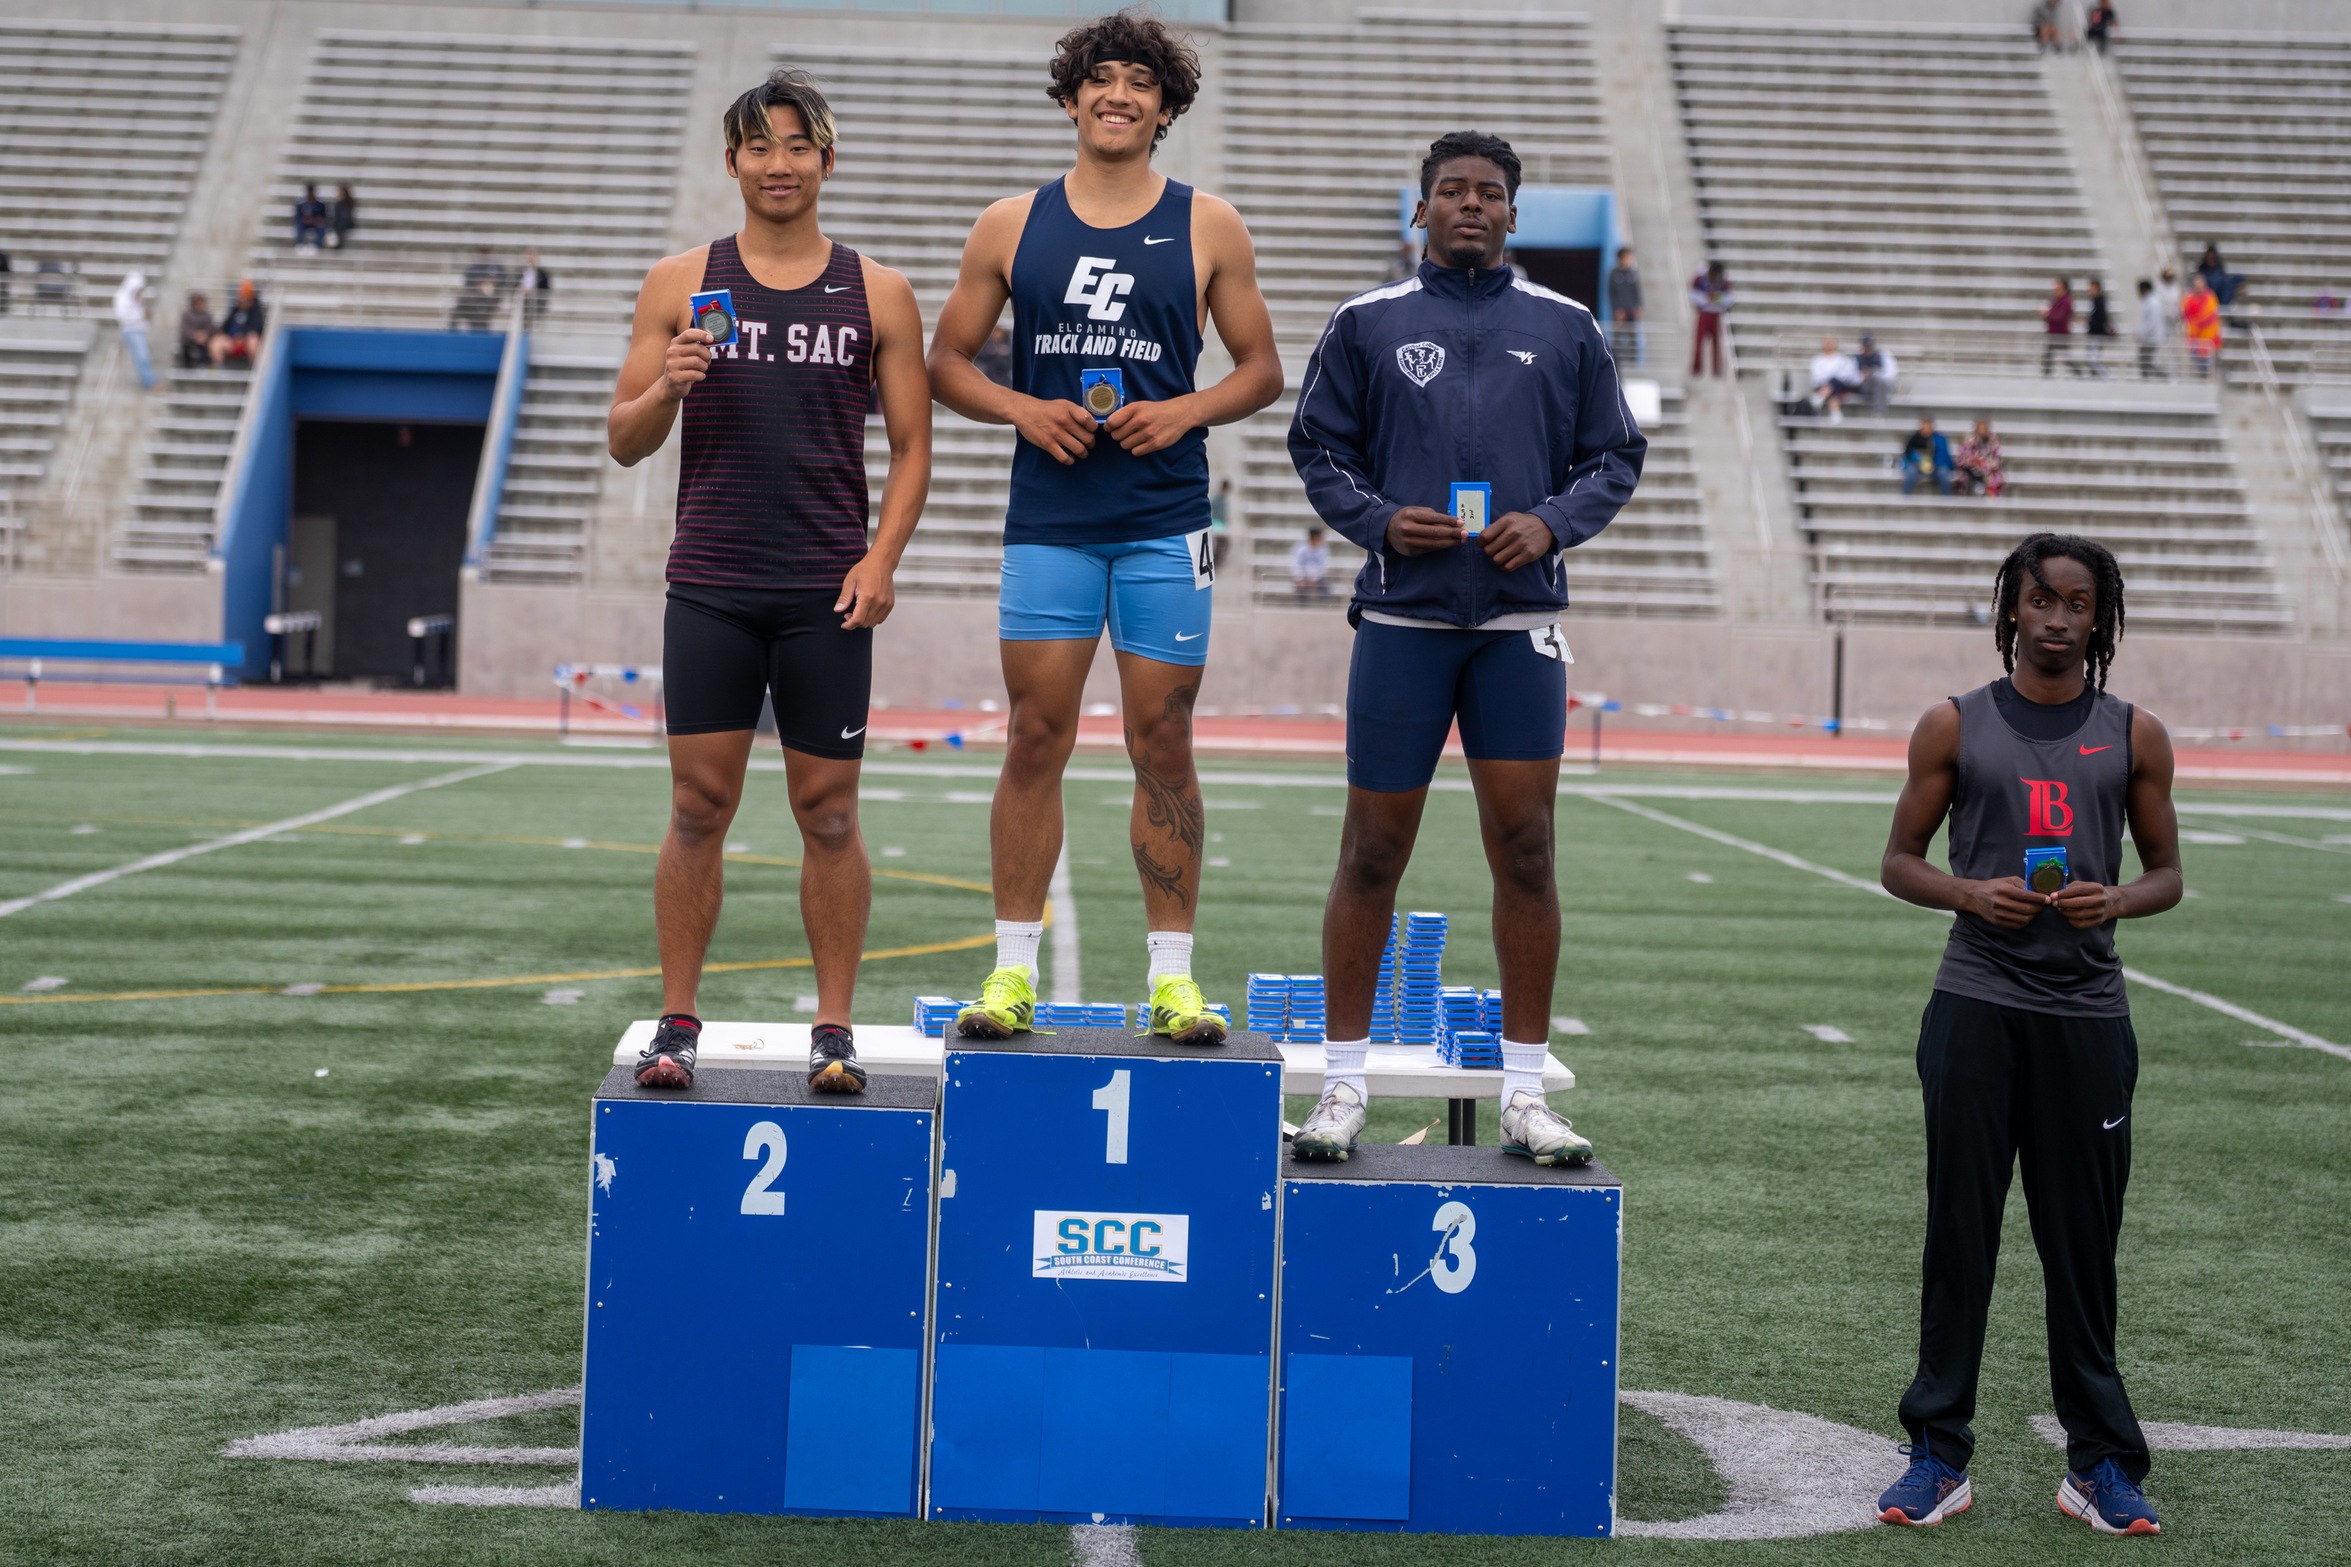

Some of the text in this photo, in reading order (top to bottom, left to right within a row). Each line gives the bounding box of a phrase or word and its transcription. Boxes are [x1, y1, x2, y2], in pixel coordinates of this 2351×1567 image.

[1063, 256, 1135, 321] EC
[786, 323, 859, 367] SAC
[1034, 333, 1162, 362] TRACK AND FIELD
[1199, 531, 1214, 582] 4
[2019, 776, 2074, 837] LB
[1092, 1069, 1131, 1165] 1
[740, 1120, 788, 1216] 2
[1053, 1255, 1167, 1270] SOUTH COAST CONFERENCE
[1055, 1216, 1164, 1257] SCC
[1429, 1201, 1477, 1294] 3
